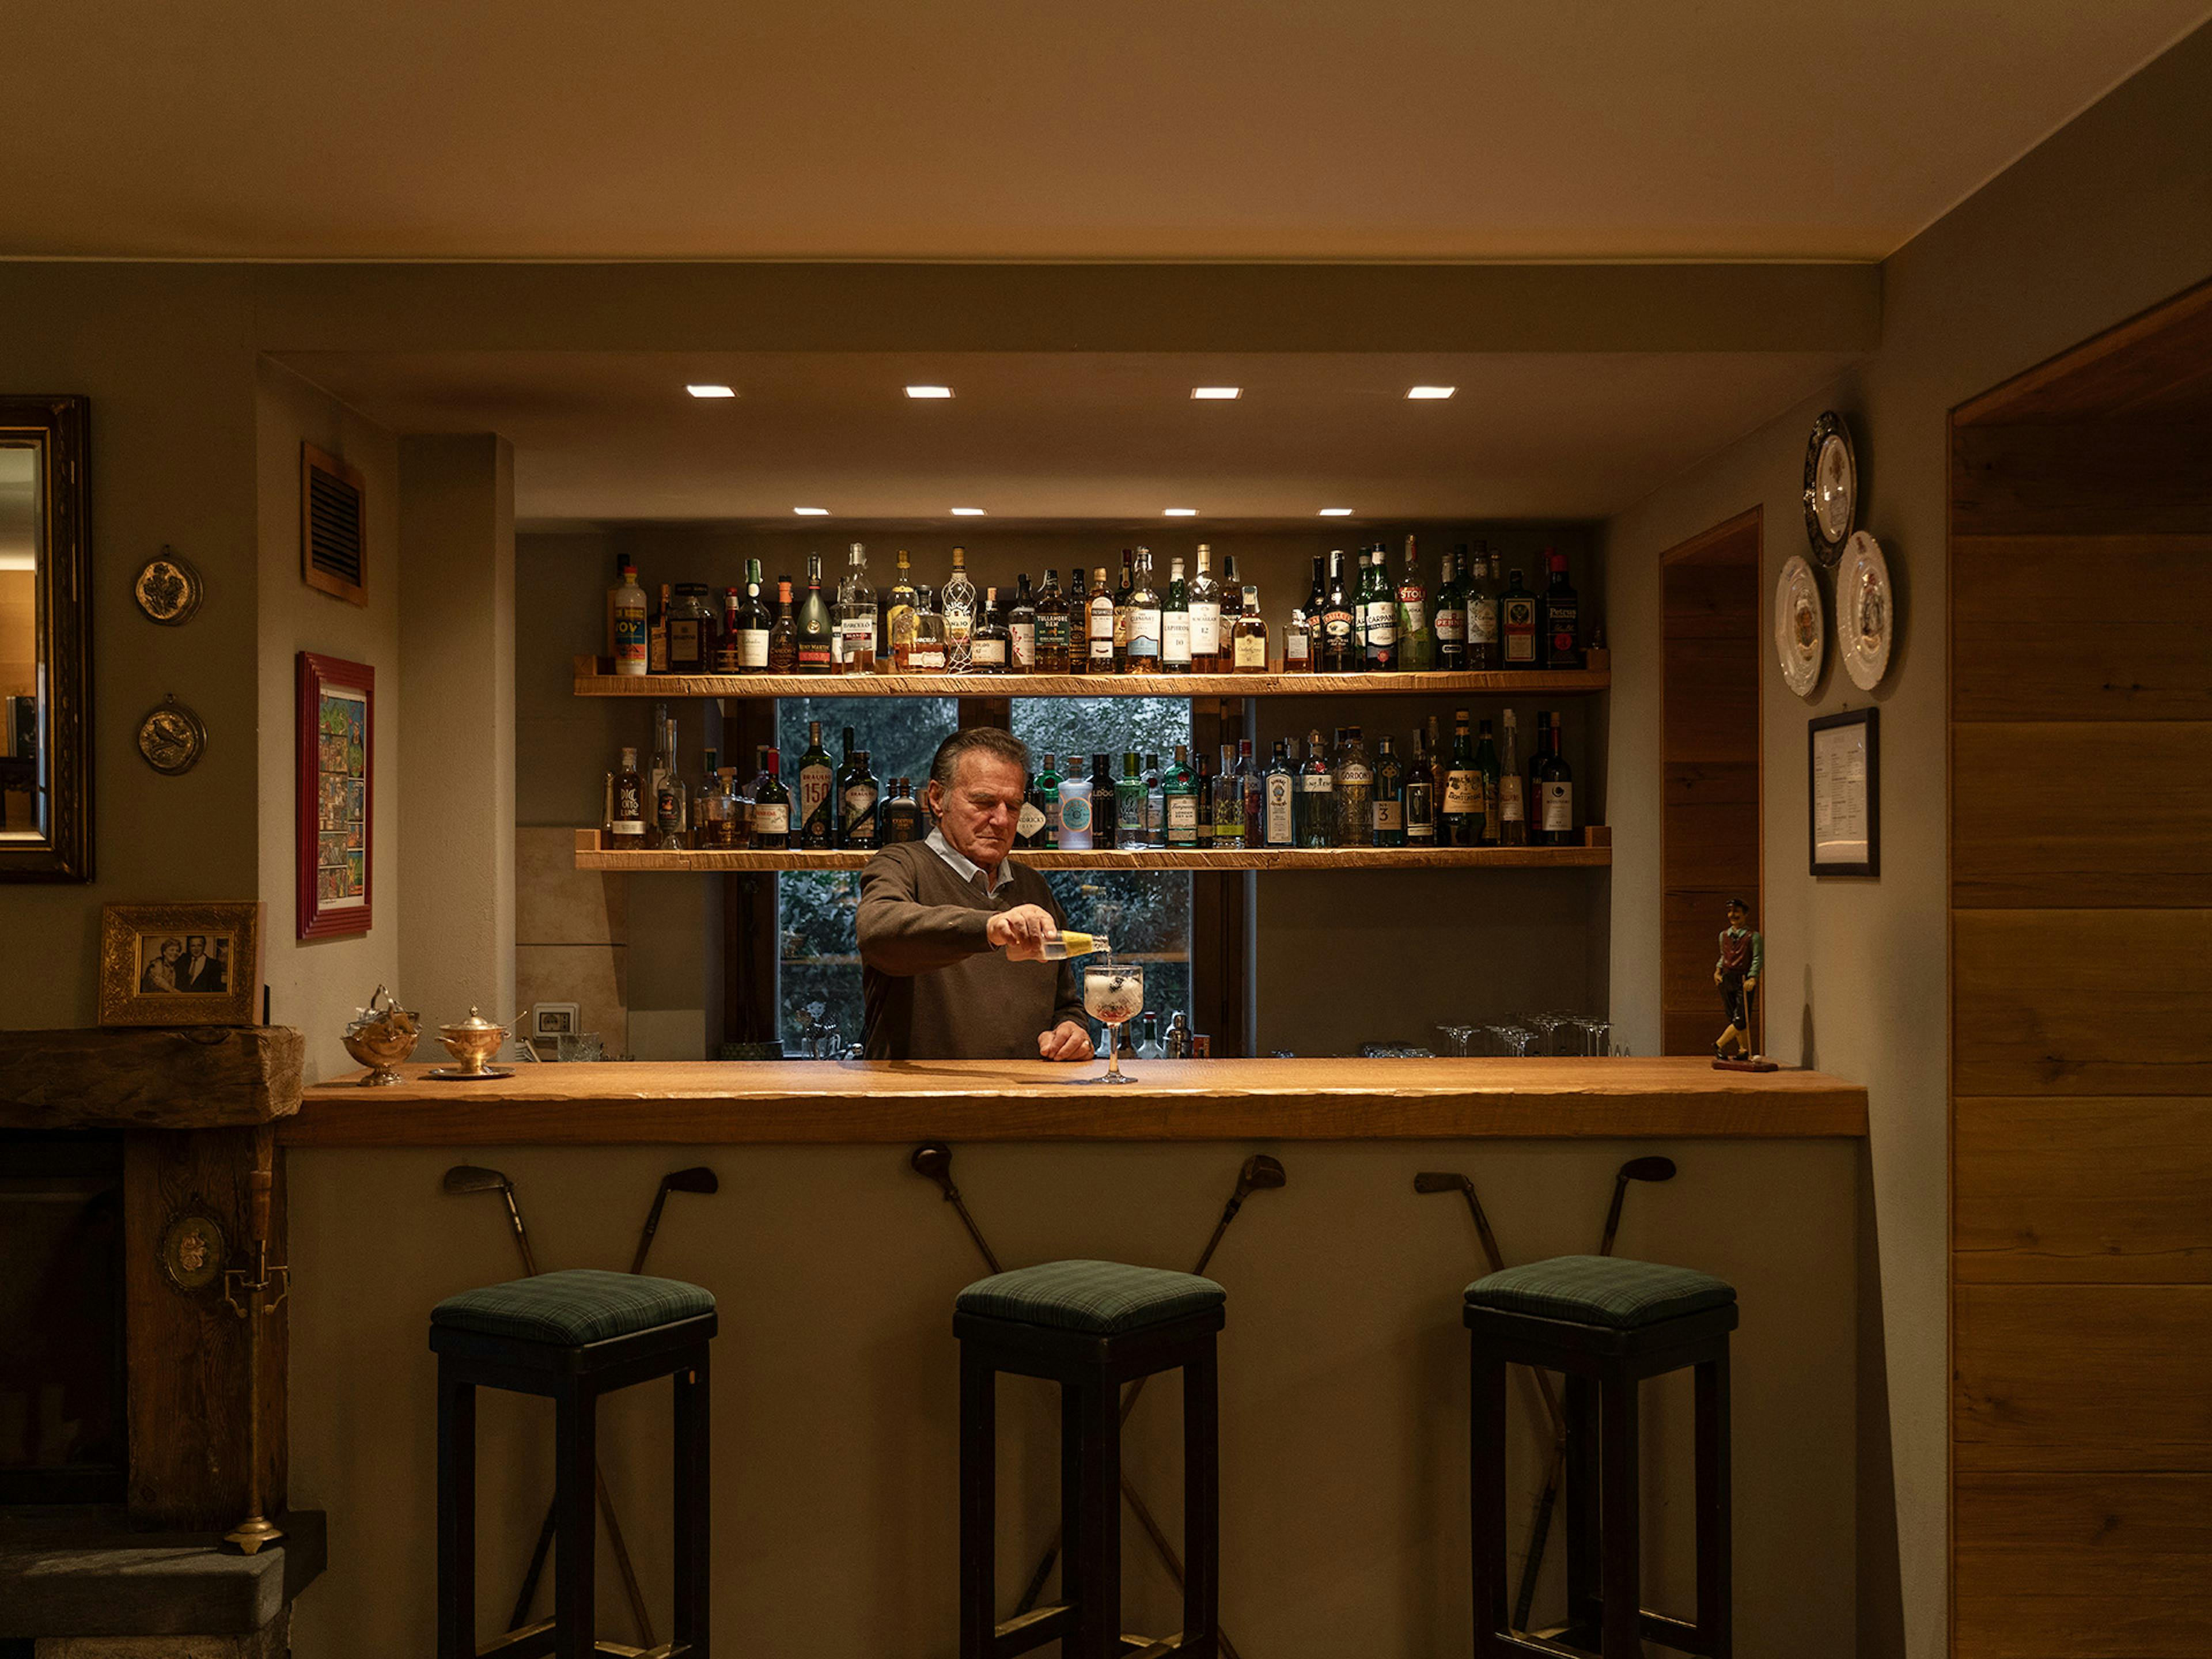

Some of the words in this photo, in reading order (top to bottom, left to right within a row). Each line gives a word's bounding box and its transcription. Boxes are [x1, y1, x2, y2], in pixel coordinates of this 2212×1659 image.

[1400, 589, 1426, 600] STOLI
[805, 783, 830, 803] 150
[1379, 808, 1389, 821] 3
